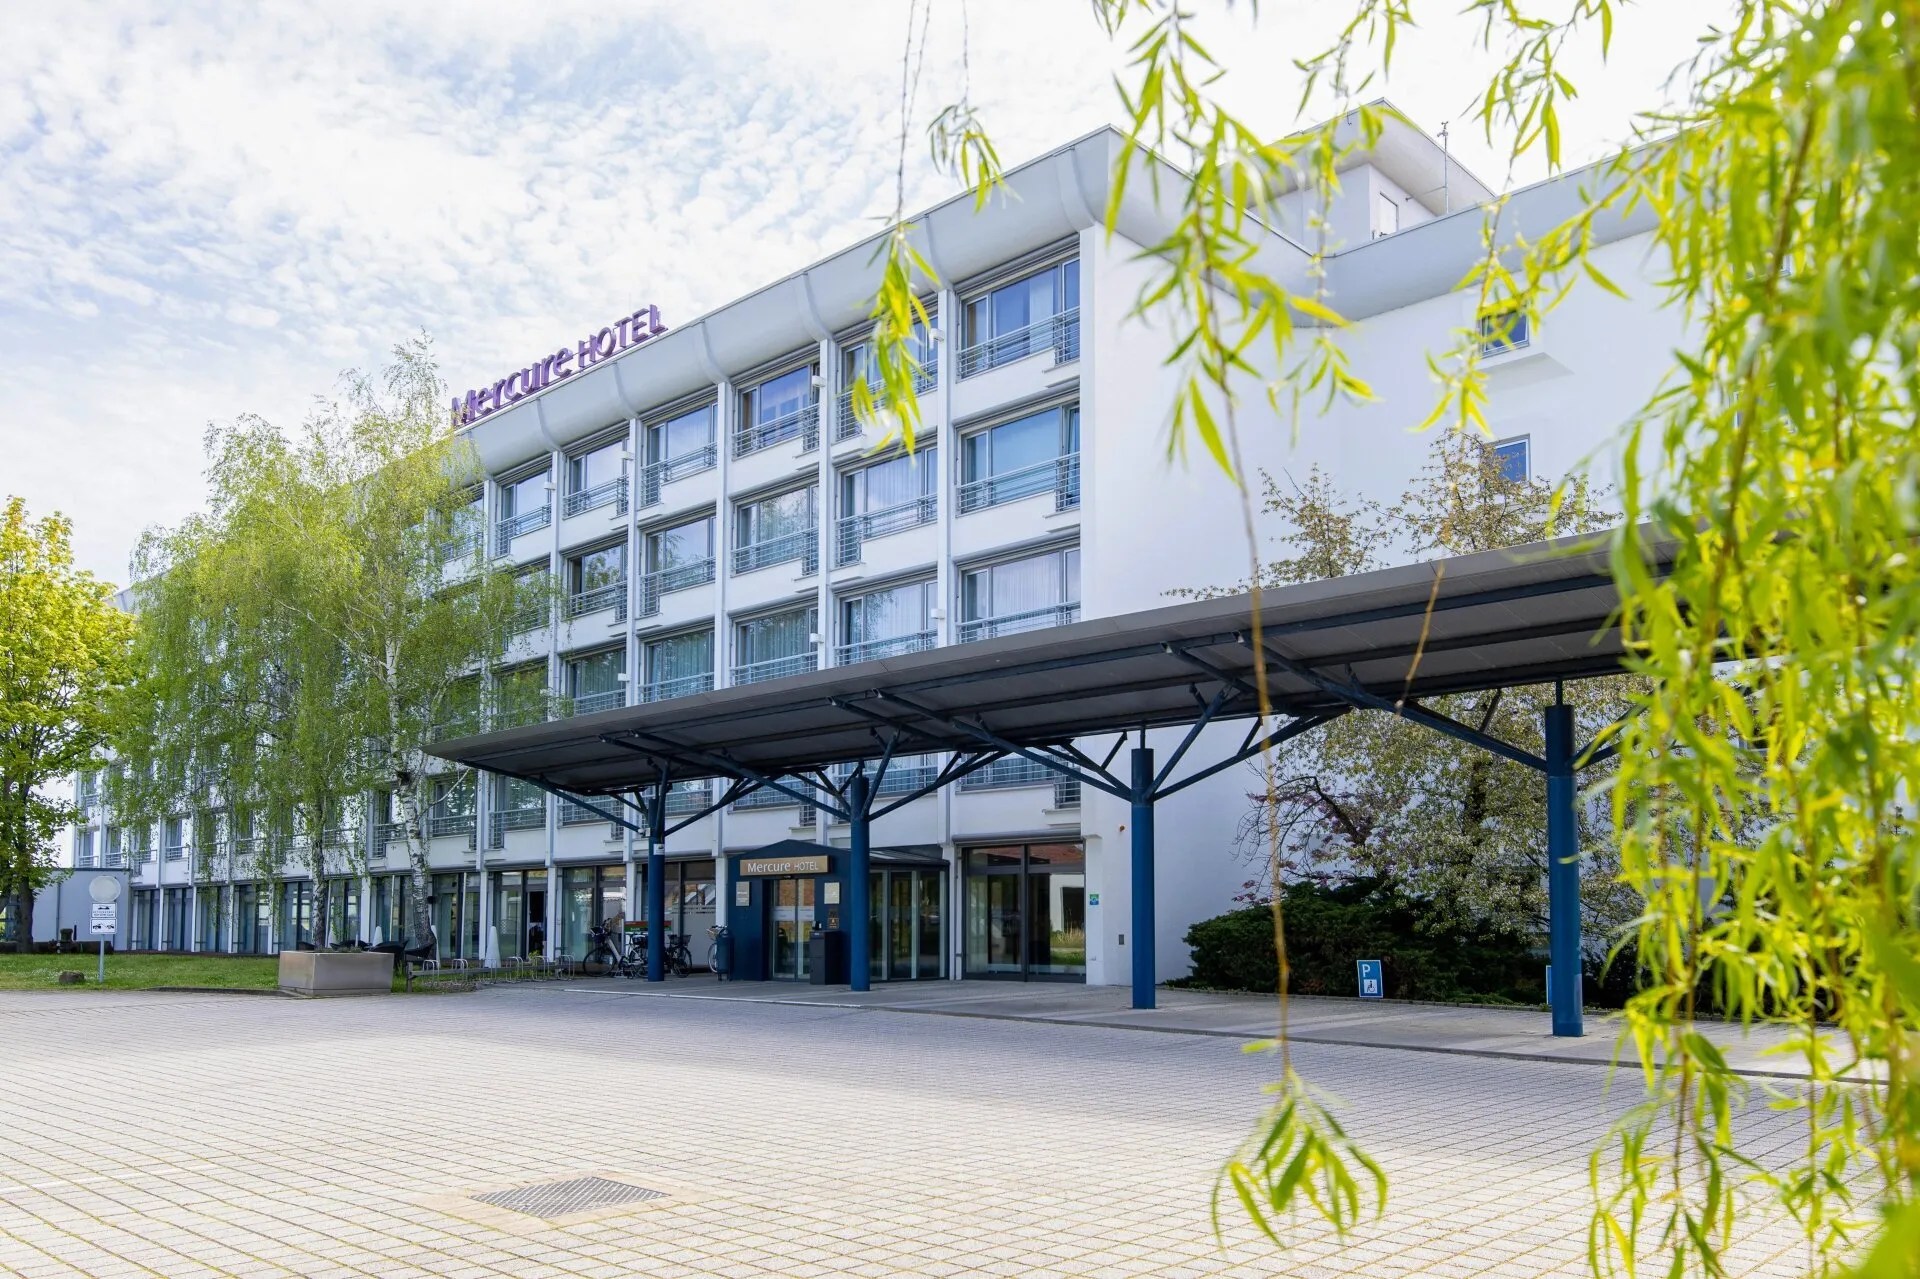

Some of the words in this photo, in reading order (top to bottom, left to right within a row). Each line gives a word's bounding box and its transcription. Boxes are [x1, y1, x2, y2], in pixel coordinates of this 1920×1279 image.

[451, 347, 573, 426] Mercure
[577, 304, 668, 368] HOTEL
[748, 862, 791, 873] Mercure
[794, 861, 818, 871] HOTEL
[1361, 963, 1370, 977] P
